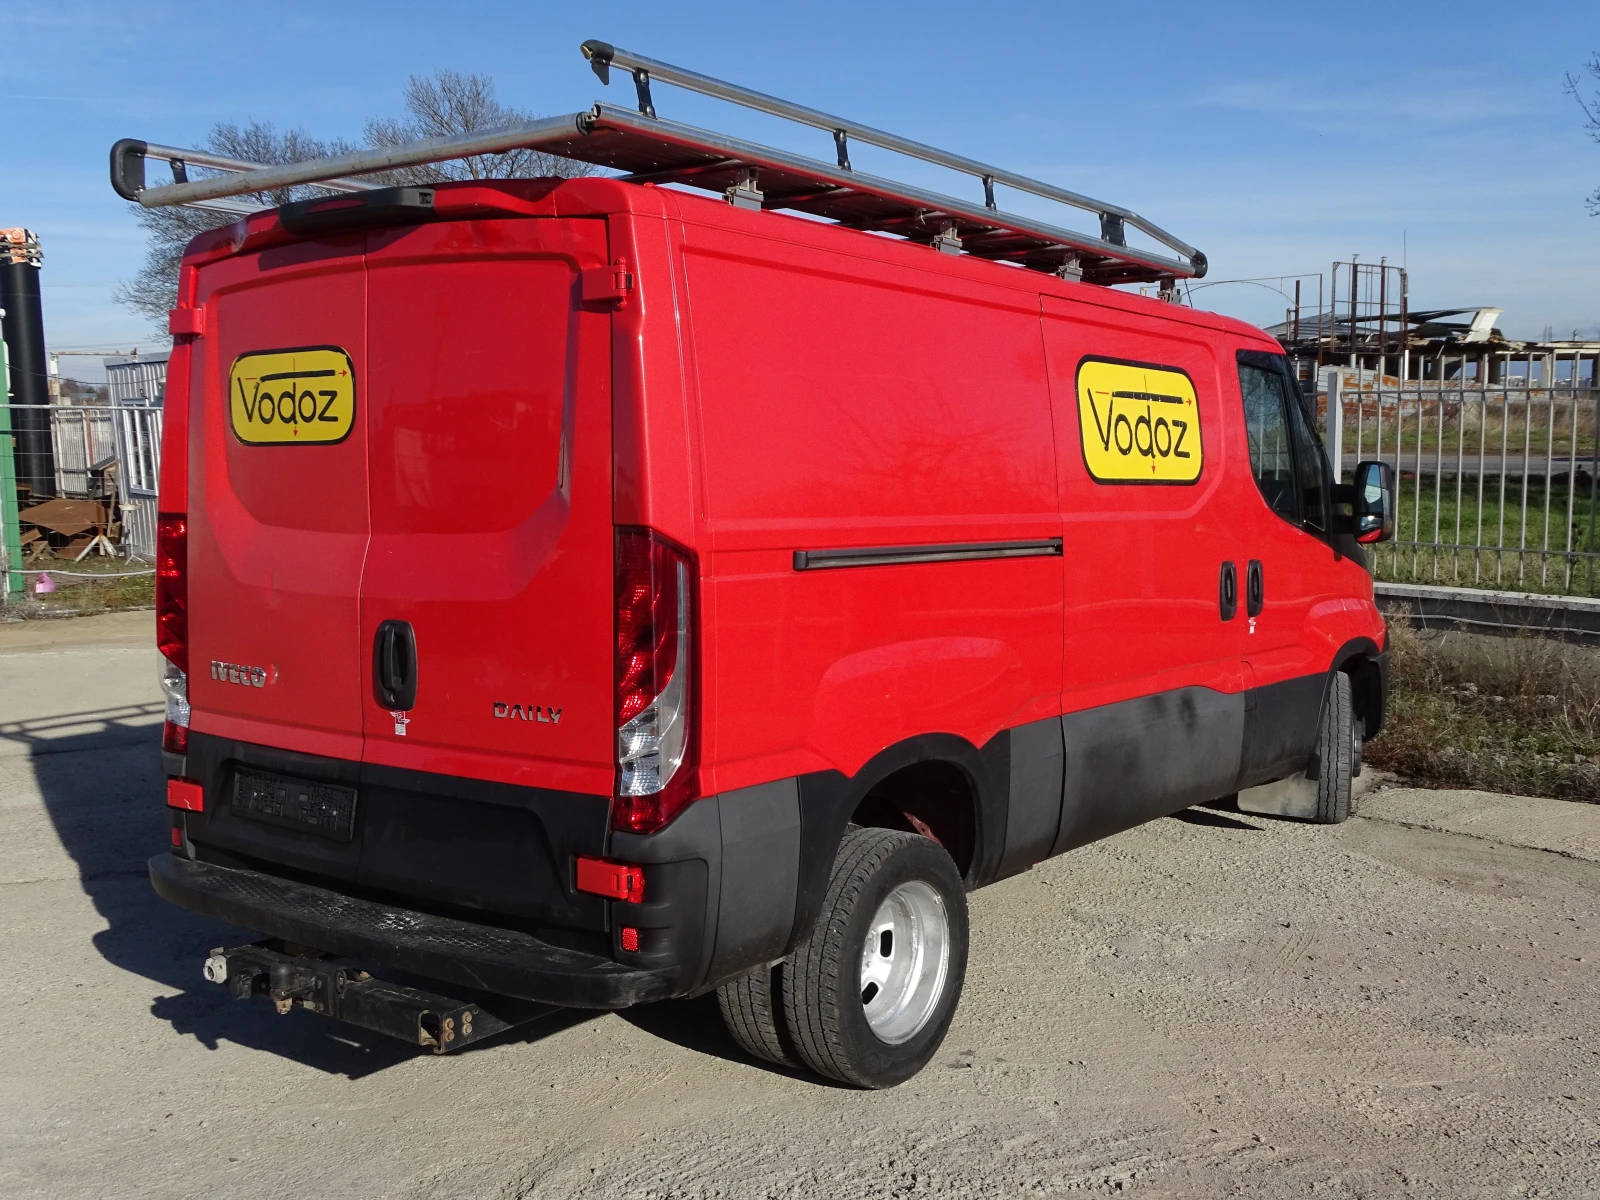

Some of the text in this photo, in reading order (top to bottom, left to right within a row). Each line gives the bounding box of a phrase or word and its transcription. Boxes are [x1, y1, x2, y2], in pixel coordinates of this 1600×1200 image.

[237, 376, 339, 425] Vodoz
[1086, 387, 1191, 459] Vodoz
[210, 660, 267, 688] IVECO
[493, 701, 563, 724] DAILY
